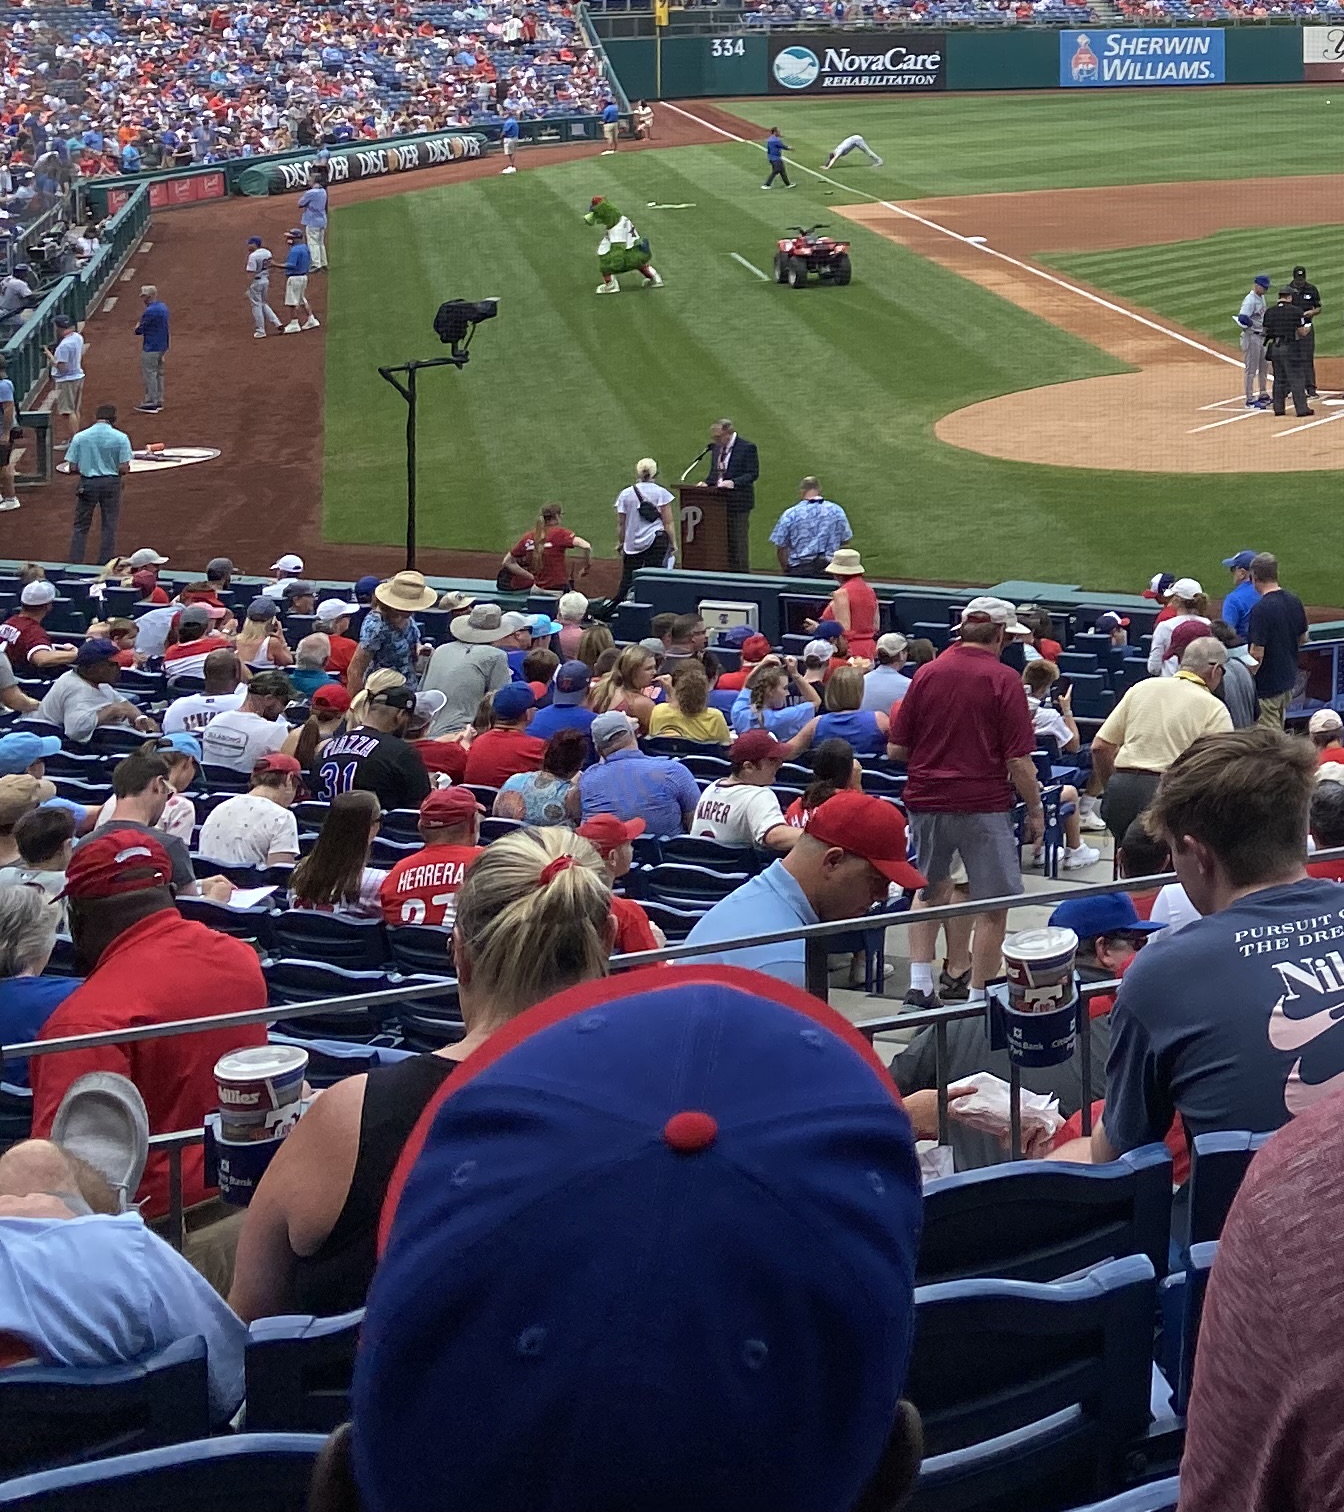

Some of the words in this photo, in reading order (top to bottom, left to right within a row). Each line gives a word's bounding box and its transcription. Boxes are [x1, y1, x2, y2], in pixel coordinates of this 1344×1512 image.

[711, 39, 746, 57] 334
[1104, 34, 1211, 57] SHERWIN
[822, 47, 940, 72] NovaCare
[822, 74, 936, 87] REHABILITATION
[682, 505, 703, 544] P
[323, 734, 380, 759] PIAZZA
[397, 862, 465, 893] HERRERA
[1233, 911, 1329, 944] PURSUIT
[1239, 937, 1291, 959] THE
